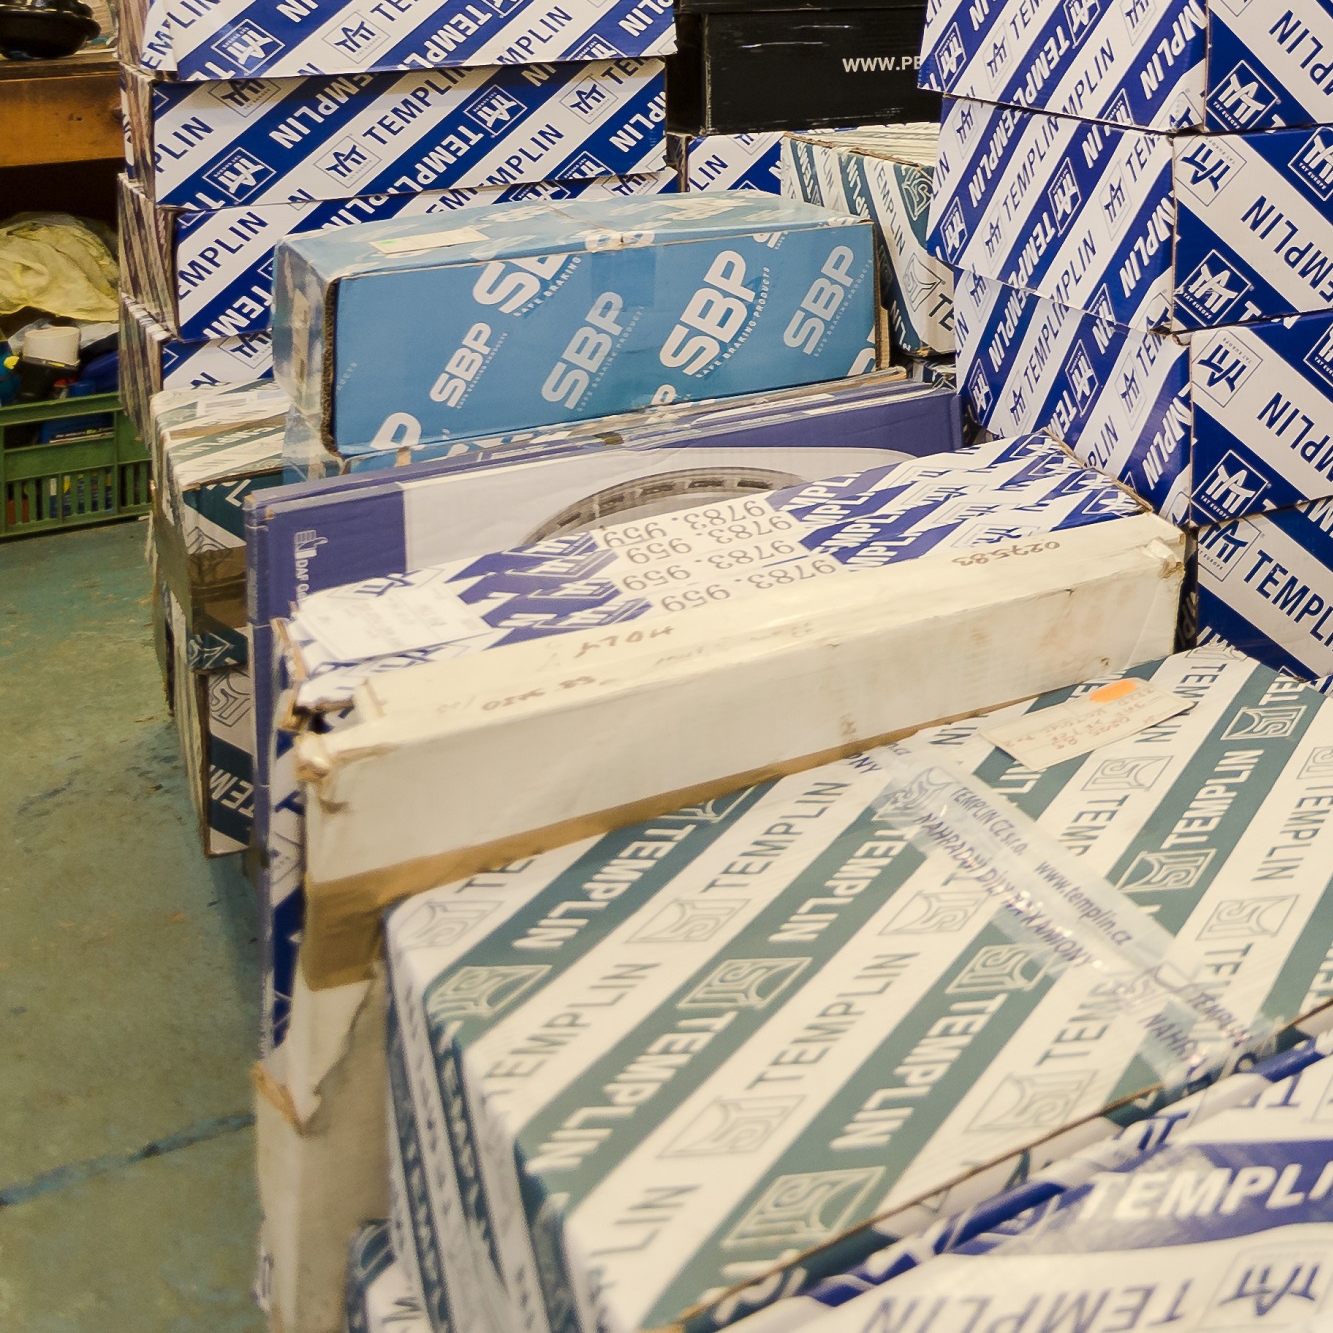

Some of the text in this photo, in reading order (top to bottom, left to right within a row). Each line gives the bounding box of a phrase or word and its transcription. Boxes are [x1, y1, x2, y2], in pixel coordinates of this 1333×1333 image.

[399, 5, 492, 68] TEMPL
[842, 56, 922, 73] WWW.PE
[393, 124, 484, 193] TEMPL
[659, 250, 757, 379] SBP
[722, 320, 757, 361] BRAKING
[751, 265, 772, 323] PRODUCTS
[783, 245, 855, 357] SBP
[429, 322, 493, 409] SBP
[540, 291, 624, 411] SBP
[603, 500, 766, 550] 9783. 959
[623, 540, 795, 592] 9783. 959
[627, 515, 793, 565] 9783. 959
[953, 540, 1061, 566] 027583
[661, 559, 837, 613] 9783. 959
[703, 780, 850, 893] TEMPLIN
[950, 786, 997, 833] TEMPLIN
[990, 818, 1013, 842] CZ
[1161, 749, 1264, 850] TEMPLIN
[514, 823, 696, 949] TEMPLIN
[1035, 861, 1133, 946] www.templin.cz
[753, 951, 922, 1091] TEMPLIN
[528, 1013, 733, 1171] TEMPLIN
[831, 993, 1008, 1151] TEMPLIN
